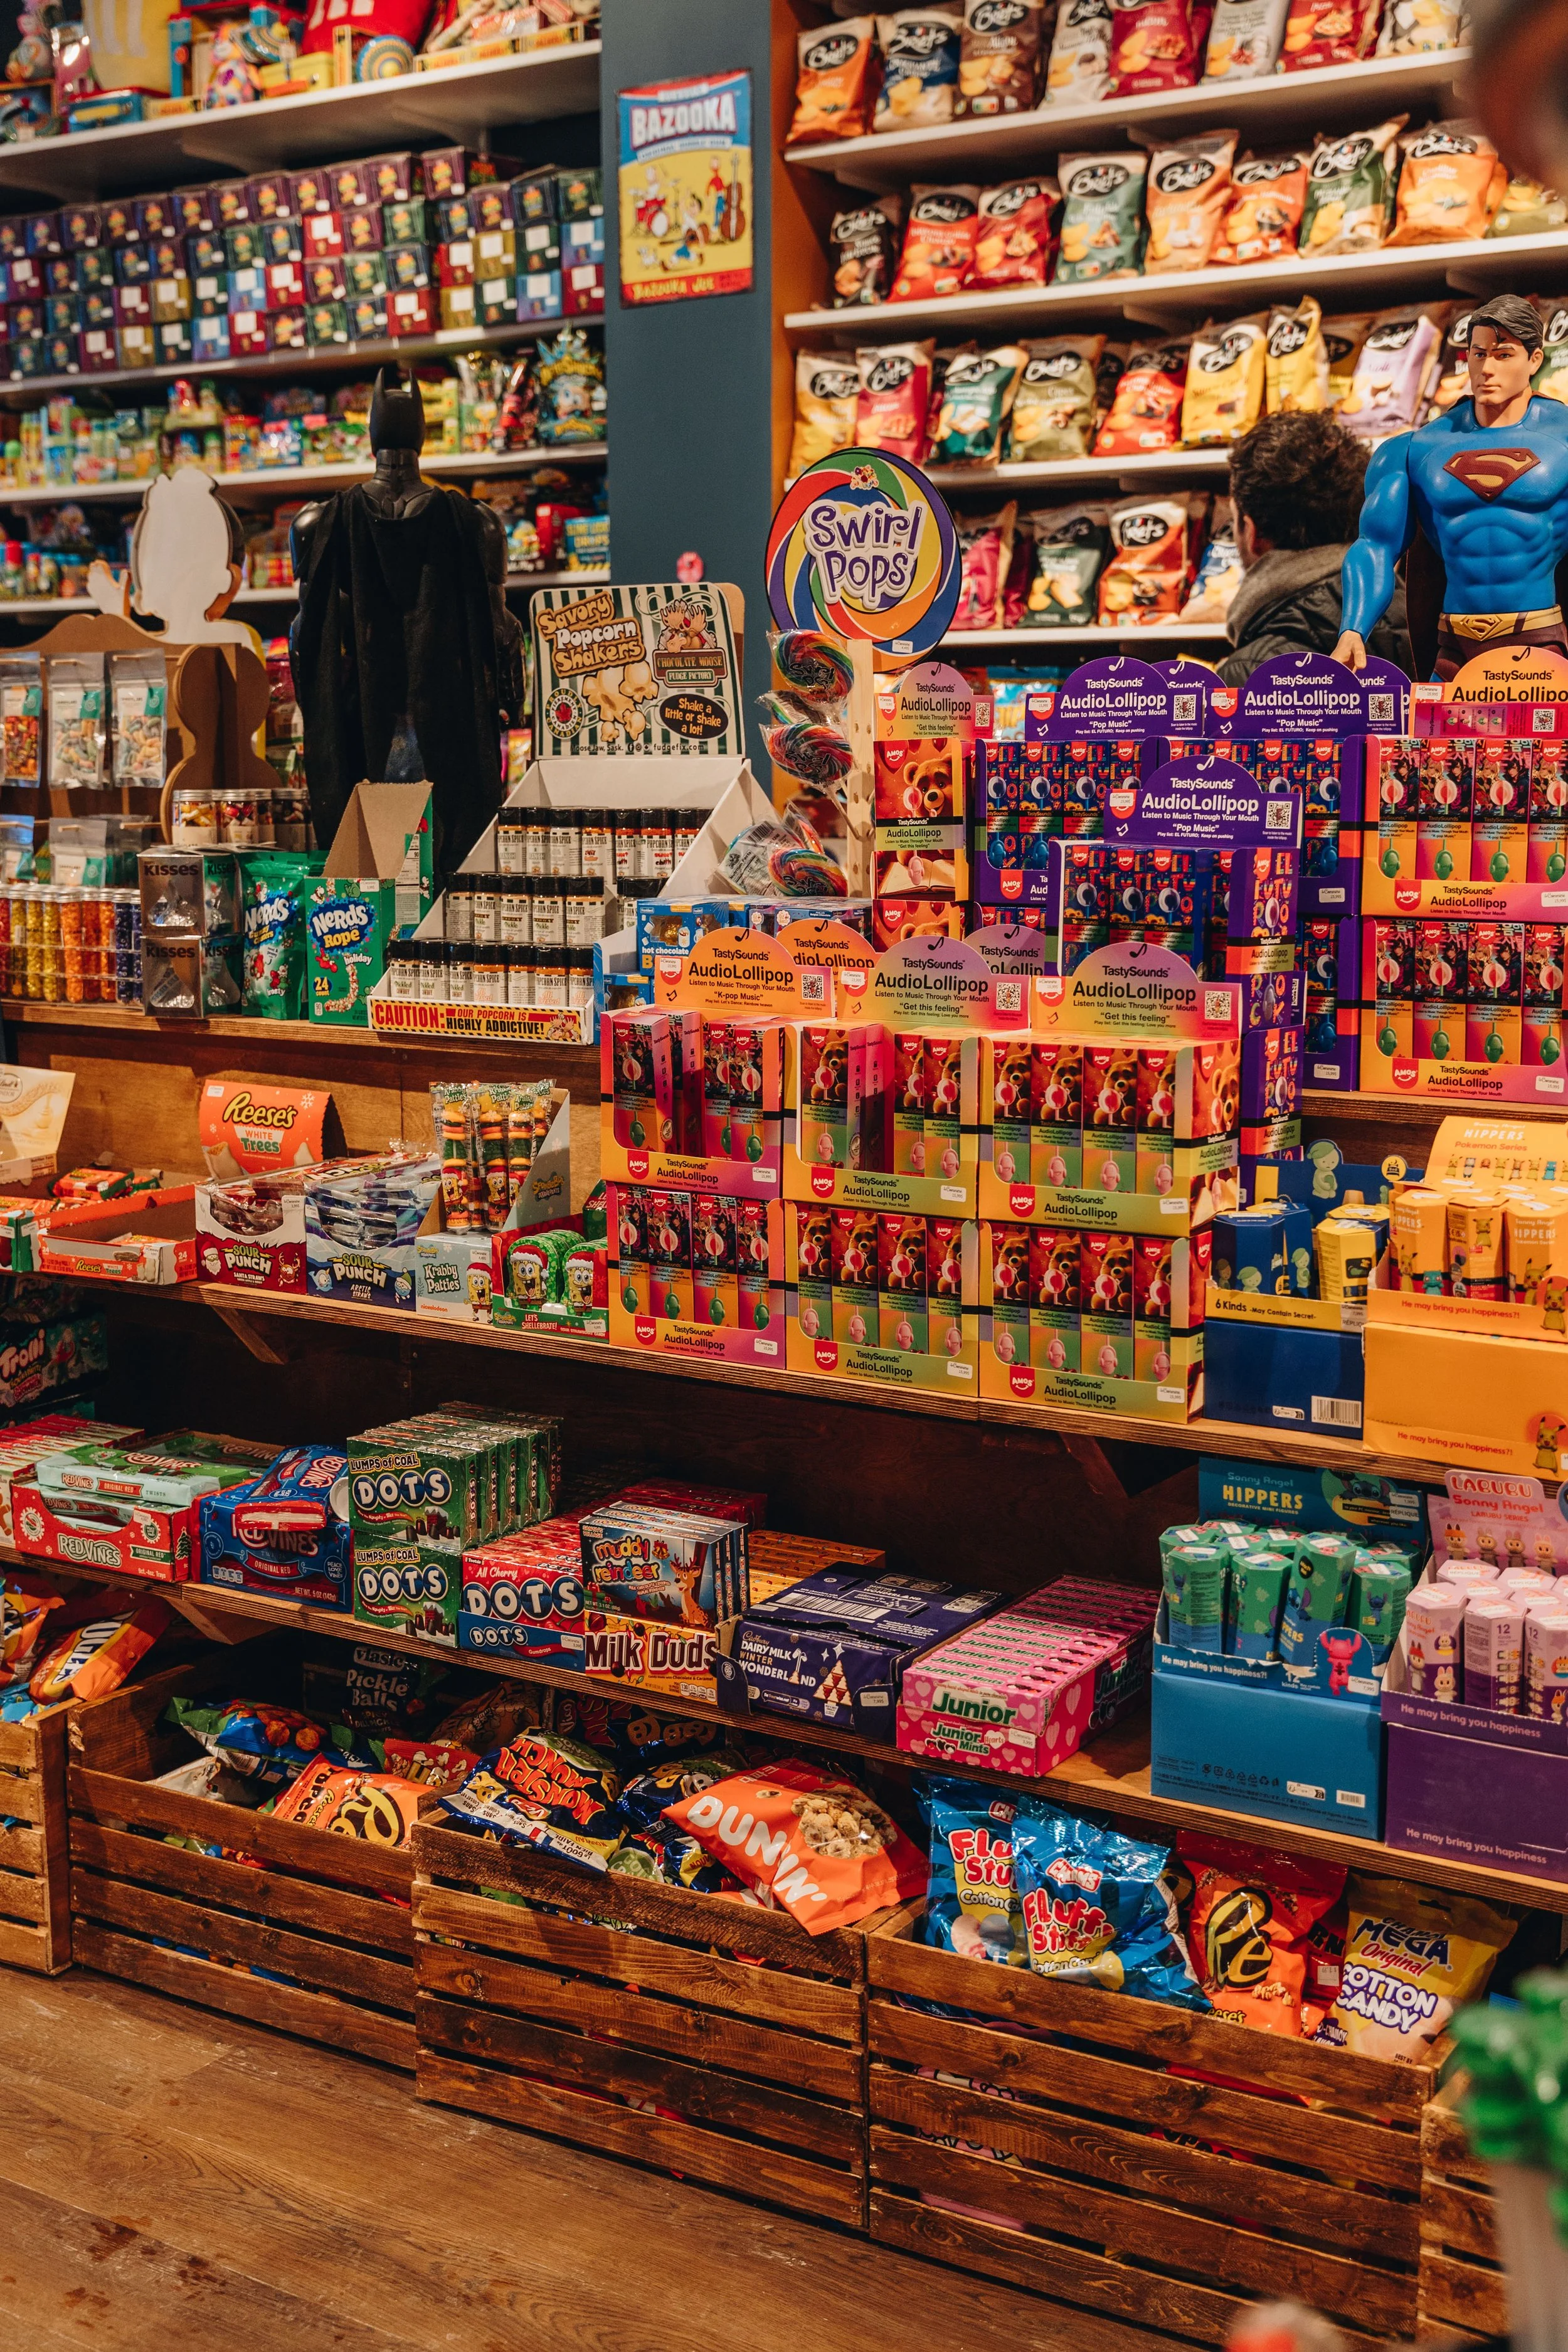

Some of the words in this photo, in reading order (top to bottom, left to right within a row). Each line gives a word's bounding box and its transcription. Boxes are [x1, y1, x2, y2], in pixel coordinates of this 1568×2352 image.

[631, 93, 736, 148] BAZOOKA
[810, 505, 923, 550] Swirl
[825, 550, 909, 598] Pops
[539, 595, 612, 633] Savory
[554, 621, 637, 650] Popcorn
[554, 640, 644, 672] Shakers
[657, 658, 696, 668] CHOCOLATE
[699, 656, 723, 666] MOOSE
[669, 672, 687, 681] FUDGE
[689, 671, 712, 679] FACTORY
[546, 689, 581, 709] PROUDLY
[679, 698, 703, 712] Shake
[706, 706, 712, 714] a
[901, 697, 971, 714] AudioLollipop
[1060, 692, 1167, 710] AudioLollipop
[1244, 690, 1360, 709] AudioLollipop
[665, 707, 683, 721] little
[686, 712, 695, 723] or
[697, 713, 721, 727] shake
[547, 718, 582, 737] CANADIAN
[681, 725, 687, 733] a
[689, 725, 702, 735] lot!
[592, 743, 605, 753] Jaw,
[607, 743, 623, 751] Sask.
[654, 744, 704, 753] fudgefix.com
[1142, 793, 1259, 815] AudioLollipop
[143, 864, 199, 876] KISSES
[1397, 891, 1420, 899] AMOS
[1431, 896, 1507, 910] AudioLollipop
[324, 930, 360, 948] Rope
[146, 946, 196, 958] KISSES
[344, 953, 372, 965] holiday
[642, 946, 655, 955] hot
[657, 947, 689, 956] chocolate
[689, 962, 793, 985] AudioLollipop
[314, 977, 329, 990] 24
[875, 972, 988, 995] AudioLollipop
[1073, 981, 1196, 1004] AudioLollipop
[375, 1002, 445, 1029] CAUTION:
[457, 1009, 474, 1018] OUR
[477, 1009, 515, 1020] POPCORN
[517, 1012, 526, 1020] IS
[446, 1017, 482, 1031] HIGHLY
[486, 1019, 544, 1034] ADDICTIVE!
[1428, 1076, 1503, 1090] AudioLollipop
[223, 1092, 297, 1128] Reese's
[245, 1130, 273, 1140] WHITE
[1464, 1129, 1524, 1140] HIPPERS
[240, 1138, 280, 1153] Trees
[1455, 1142, 1496, 1150] Pokemon
[1012, 1196, 1034, 1205] AMOS
[1044, 1202, 1118, 1219] AudioLollipop
[40, 1218, 51, 1227] 36
[233, 1244, 260, 1256] SOUR
[76, 1260, 101, 1273] Reese's
[225, 1253, 272, 1274] PUNCH
[342, 1254, 373, 1268] SOUR
[333, 1263, 386, 1286] PUNCH
[425, 1264, 457, 1279] Krabby
[351, 1285, 371, 1293] ARCTIC
[427, 1278, 460, 1293] Patties
[1216, 1299, 1221, 1308] 6
[1223, 1301, 1247, 1311] Kinds
[1414, 1303, 1431, 1311] may
[1433, 1304, 1453, 1313] bring
[1472, 1308, 1520, 1319] happiness?!
[522, 1322, 557, 1330] SHELLEBRATE!
[664, 1333, 725, 1351] AudioLollipop
[1044, 1385, 1116, 1404] AudioLollipop
[351, 1459, 381, 1471] LUMPS
[383, 1457, 392, 1468] of
[395, 1454, 418, 1466] COAL
[104, 1483, 123, 1491] ORIGINAL
[358, 1474, 445, 1505] DOTS
[1228, 1473, 1260, 1485] Sonny
[1263, 1476, 1293, 1488] Angel
[1450, 1476, 1532, 1498] LABUBU
[1223, 1485, 1303, 1509] HIPPERS
[1453, 1495, 1498, 1510] Sonny
[1503, 1500, 1544, 1513] Angel
[596, 1537, 649, 1560] muddy
[255, 1561, 279, 1574] ORIGINAL
[281, 1566, 290, 1574] RED
[475, 1567, 487, 1577] All
[489, 1567, 517, 1581] Cherry
[596, 1560, 659, 1581] reindeer
[363, 1570, 442, 1596] DOTS
[467, 1582, 578, 1615] DOTS
[474, 1629, 524, 1643] DOTS
[1496, 1624, 1510, 1633] 12
[743, 1631, 770, 1645] Cadbury
[586, 1633, 642, 1668] Milk
[650, 1634, 716, 1668] Duds
[740, 1651, 773, 1666] WINTER
[741, 1641, 770, 1654] DAIRY
[770, 1648, 792, 1661] MILK
[346, 1669, 409, 1697] Pickle
[352, 1689, 397, 1711] Balls
[933, 1692, 1017, 1724] Junior
[1401, 1704, 1416, 1716] He
[1417, 1707, 1438, 1720] may
[1441, 1710, 1466, 1725] bring
[1468, 1715, 1486, 1729] you
[1489, 1719, 1540, 1739] happiness
[933, 1724, 981, 1742] Junior
[985, 1736, 1004, 1744] Hearts
[959, 1741, 989, 1755] Mints
[509, 1739, 597, 1788] MUNCH
[495, 1747, 605, 1825] MONSTER
[687, 1796, 827, 1903] DUNIN'
[960, 1890, 1003, 1909] Cotton
[1352, 1919, 1450, 1965] MEGA
[1360, 1942, 1434, 1978] Original
[1343, 1963, 1436, 2016] COTTON
[1336, 1984, 1418, 2032] CANDY
